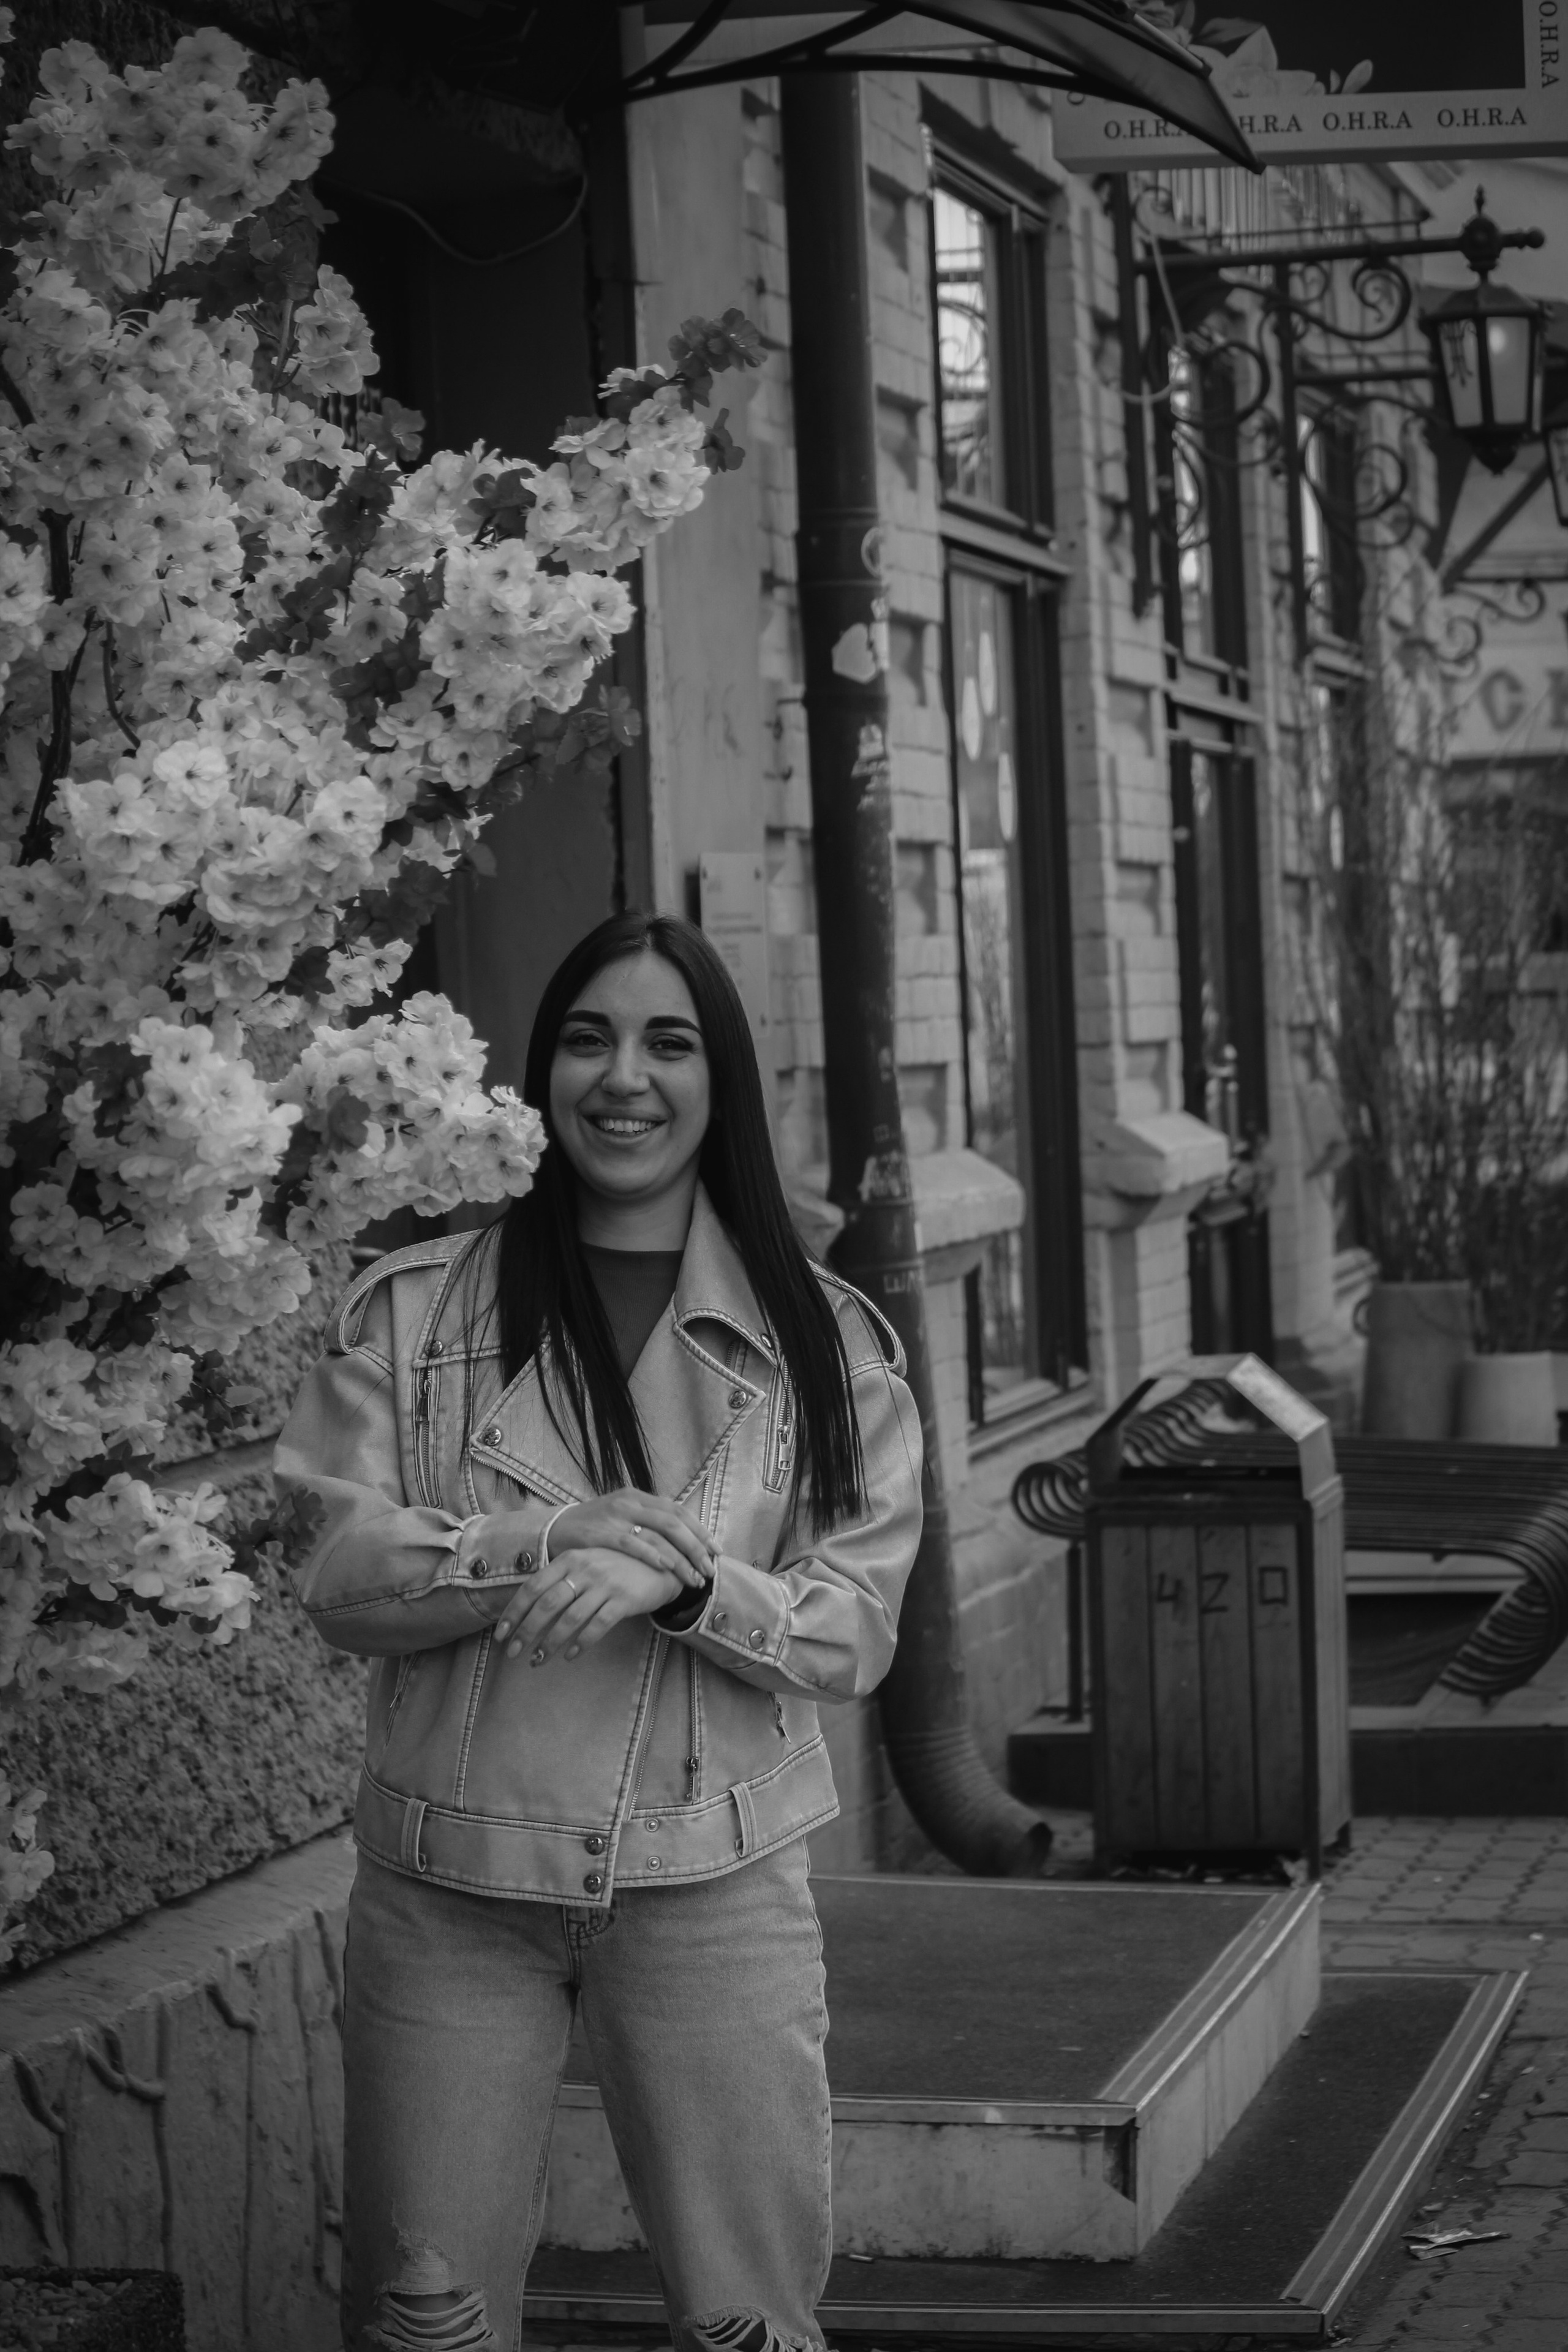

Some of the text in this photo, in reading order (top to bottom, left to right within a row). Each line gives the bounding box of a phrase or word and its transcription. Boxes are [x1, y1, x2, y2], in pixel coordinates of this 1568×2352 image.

[1539, 1, 1559, 88] O.H.R.A
[1322, 110, 1413, 131] O.H.R.A
[1437, 107, 1528, 127] O.H.R.A
